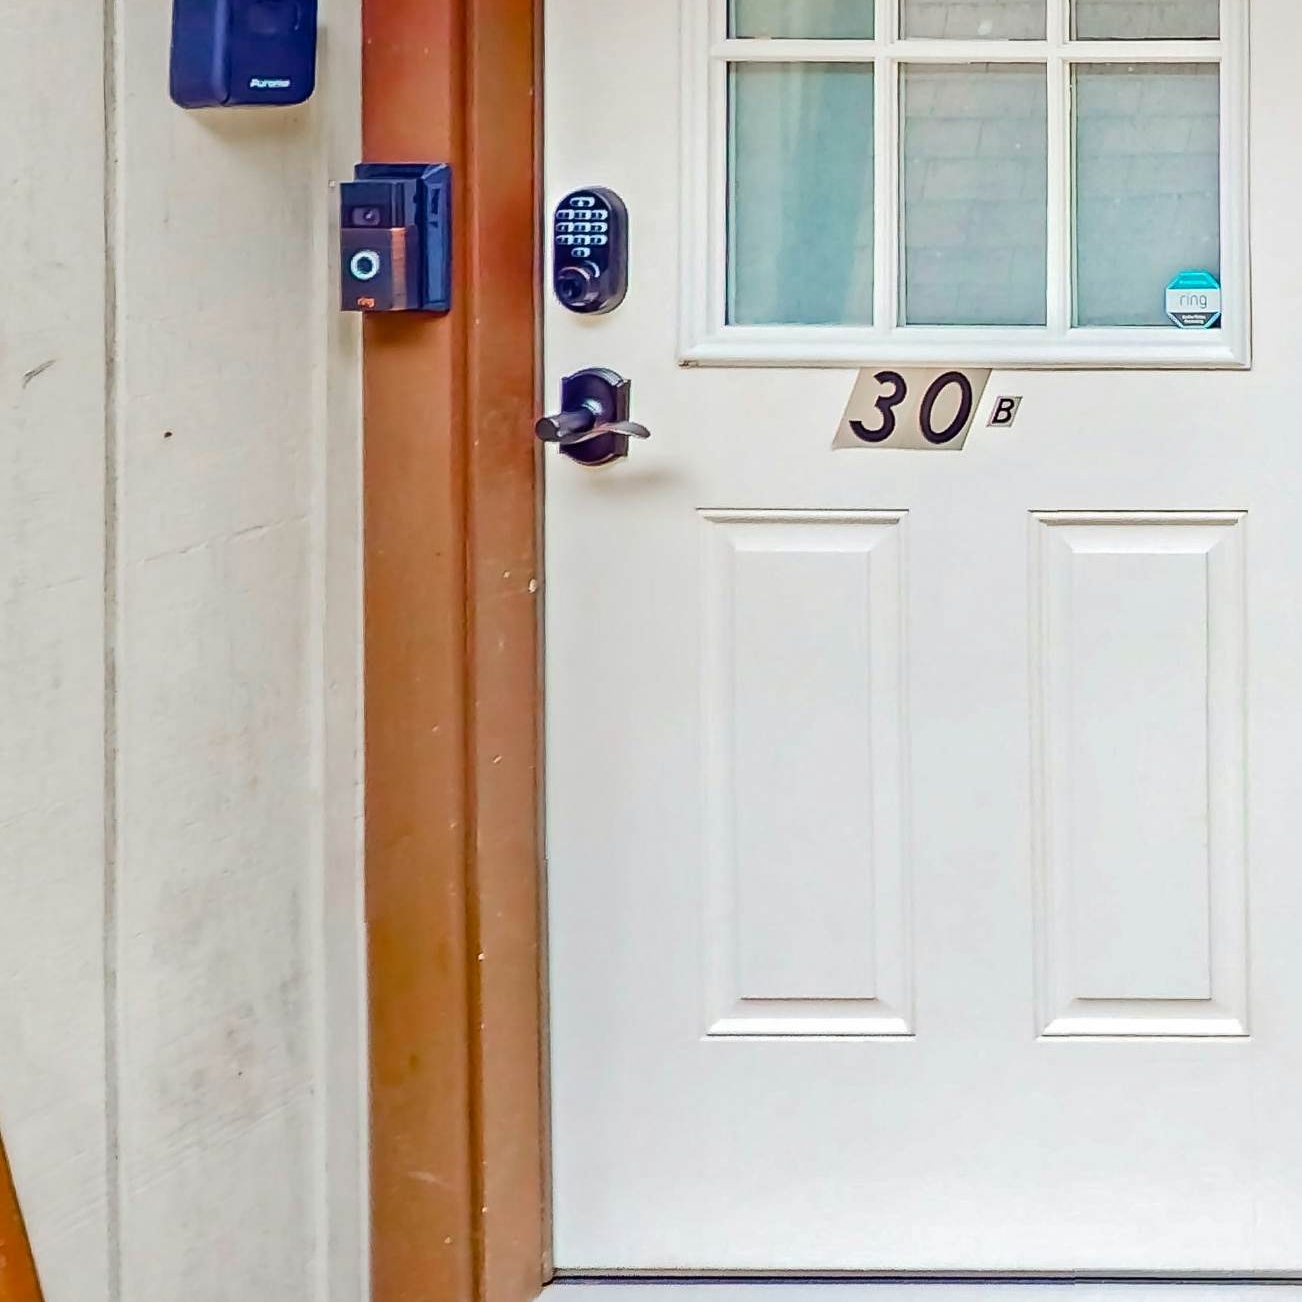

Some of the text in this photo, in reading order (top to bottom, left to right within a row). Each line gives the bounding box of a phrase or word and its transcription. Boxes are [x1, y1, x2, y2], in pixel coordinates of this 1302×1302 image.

[1179, 294, 1208, 310] ring
[849, 370, 1015, 445] 30 B
